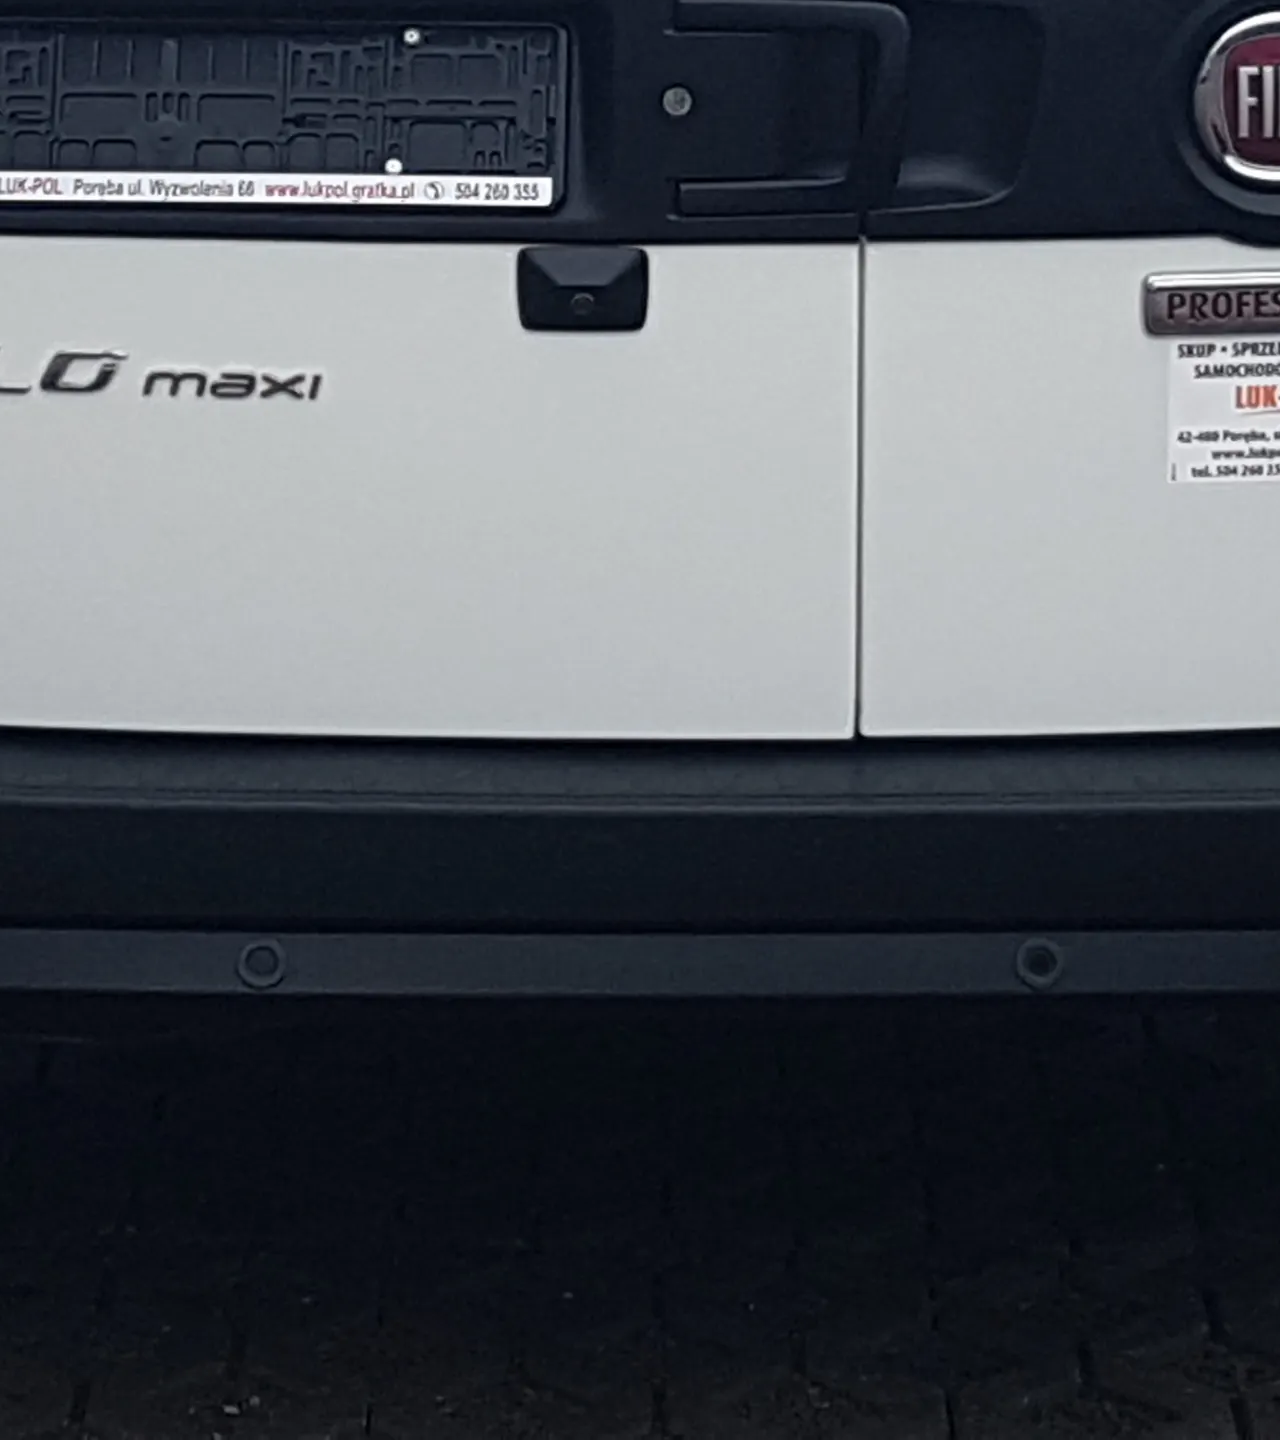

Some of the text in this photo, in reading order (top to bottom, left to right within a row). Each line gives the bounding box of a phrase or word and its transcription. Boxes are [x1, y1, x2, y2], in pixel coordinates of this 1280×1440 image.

[149, 178, 234, 202] Wyzwolenia
[455, 181, 480, 200] 504
[1177, 343, 1216, 359] SKUP
